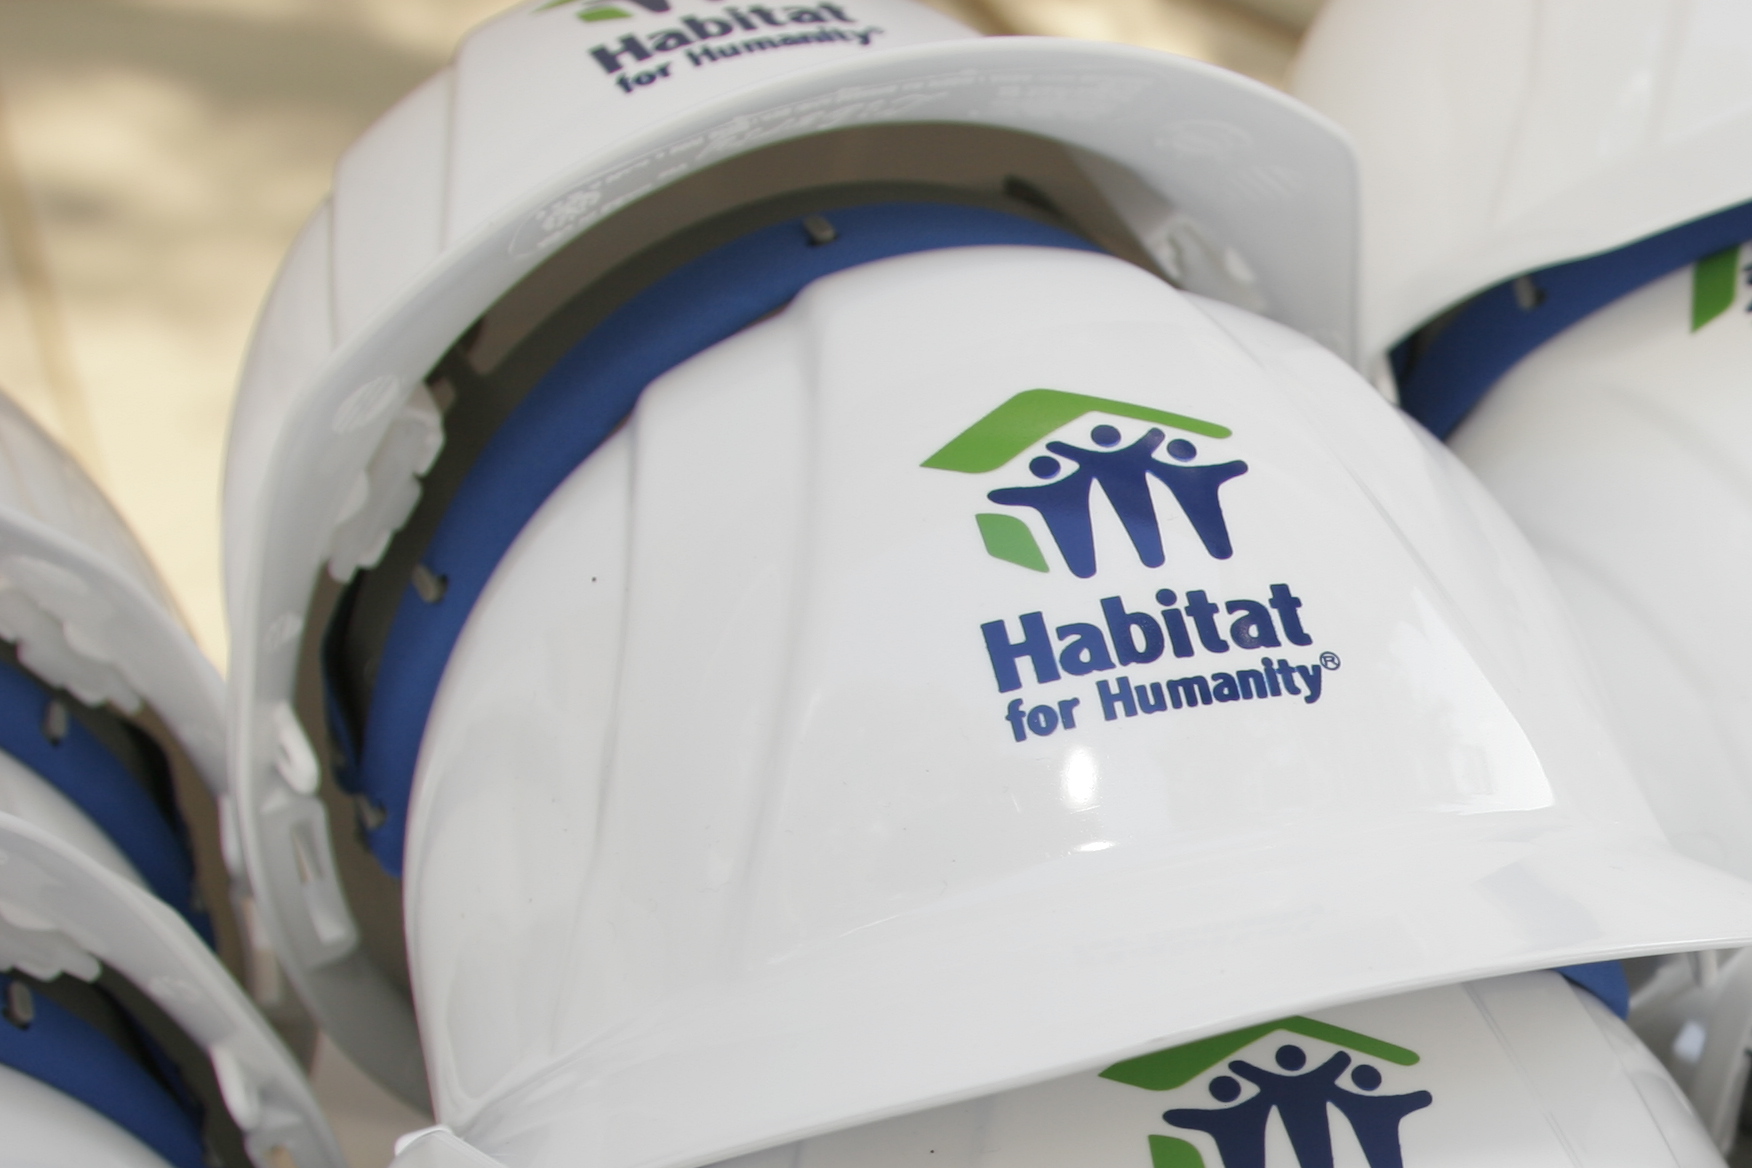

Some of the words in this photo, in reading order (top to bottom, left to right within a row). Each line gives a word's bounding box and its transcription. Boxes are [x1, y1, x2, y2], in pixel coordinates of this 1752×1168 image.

[588, 2, 856, 75] Habitat
[614, 61, 672, 94] for
[980, 583, 1313, 693] Habitat
[1005, 697, 1081, 743] for
